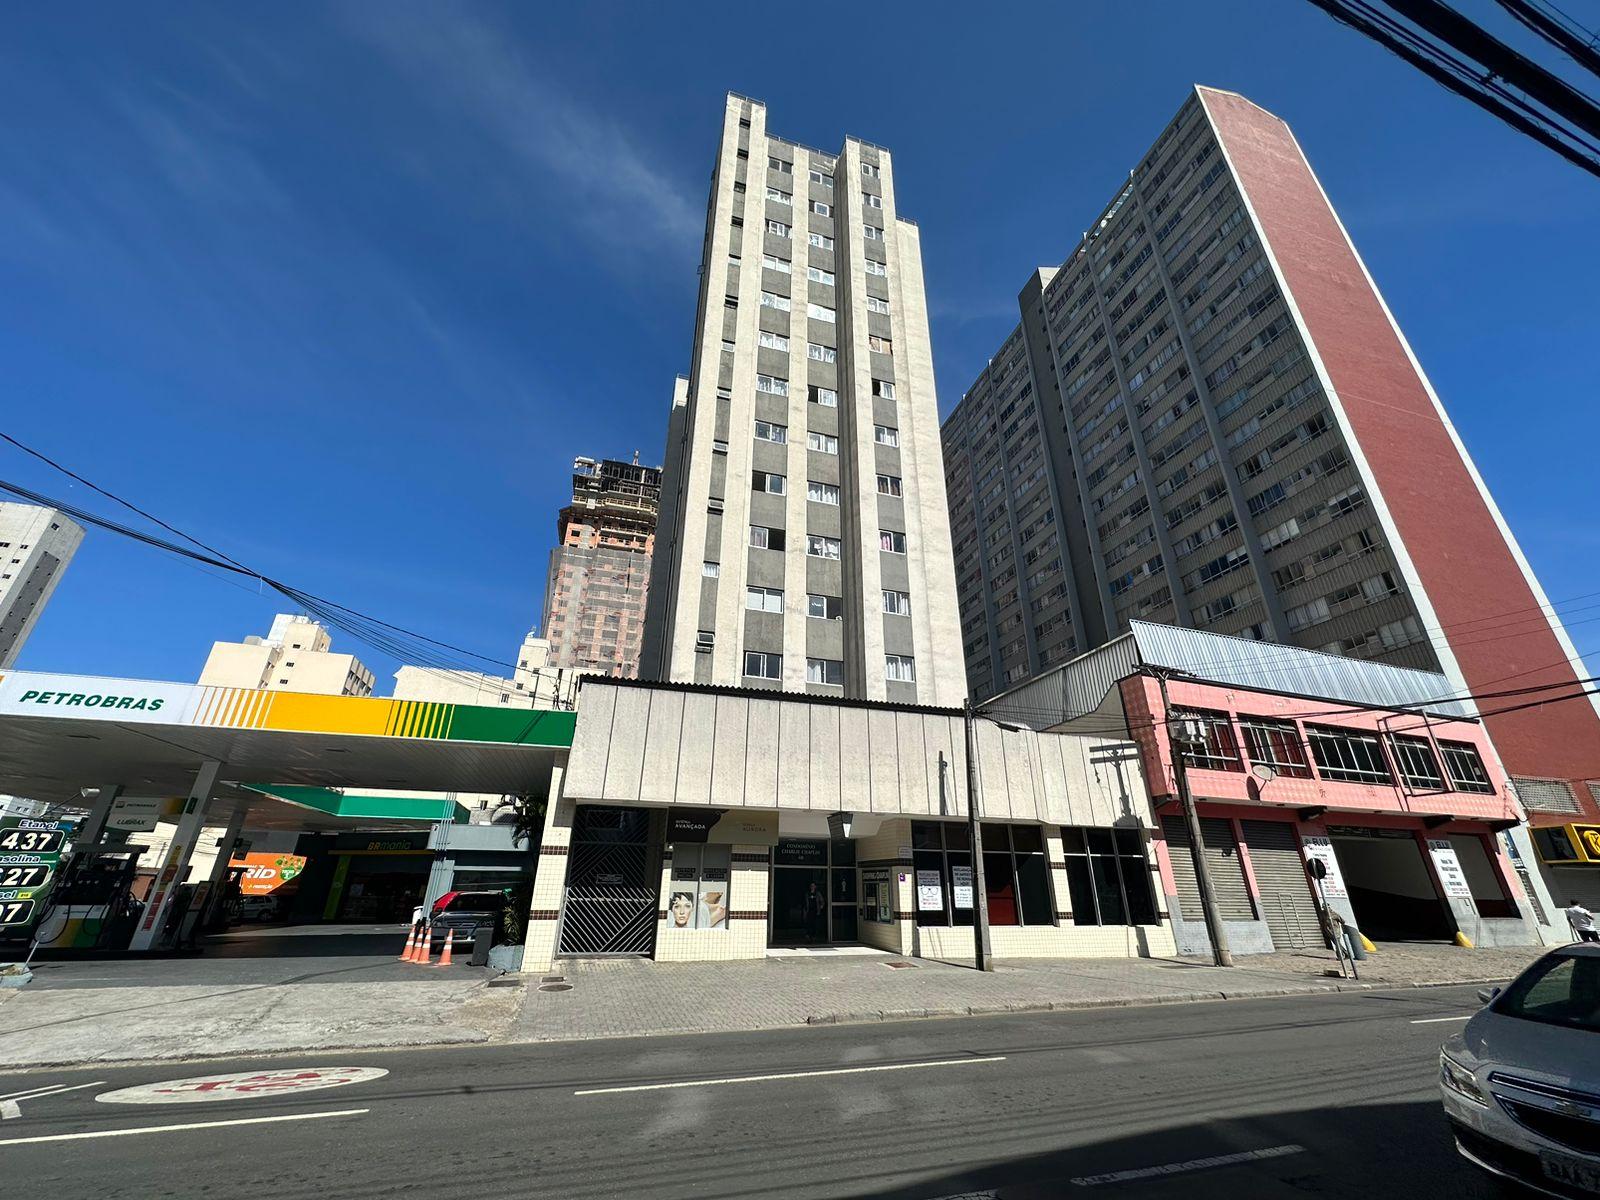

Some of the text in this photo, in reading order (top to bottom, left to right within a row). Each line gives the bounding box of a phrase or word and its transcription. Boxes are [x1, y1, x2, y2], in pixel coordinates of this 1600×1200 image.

[19, 689, 165, 712] PETROBRAS
[18, 819, 59, 830] Etanol
[1, 832, 54, 850] 4.37
